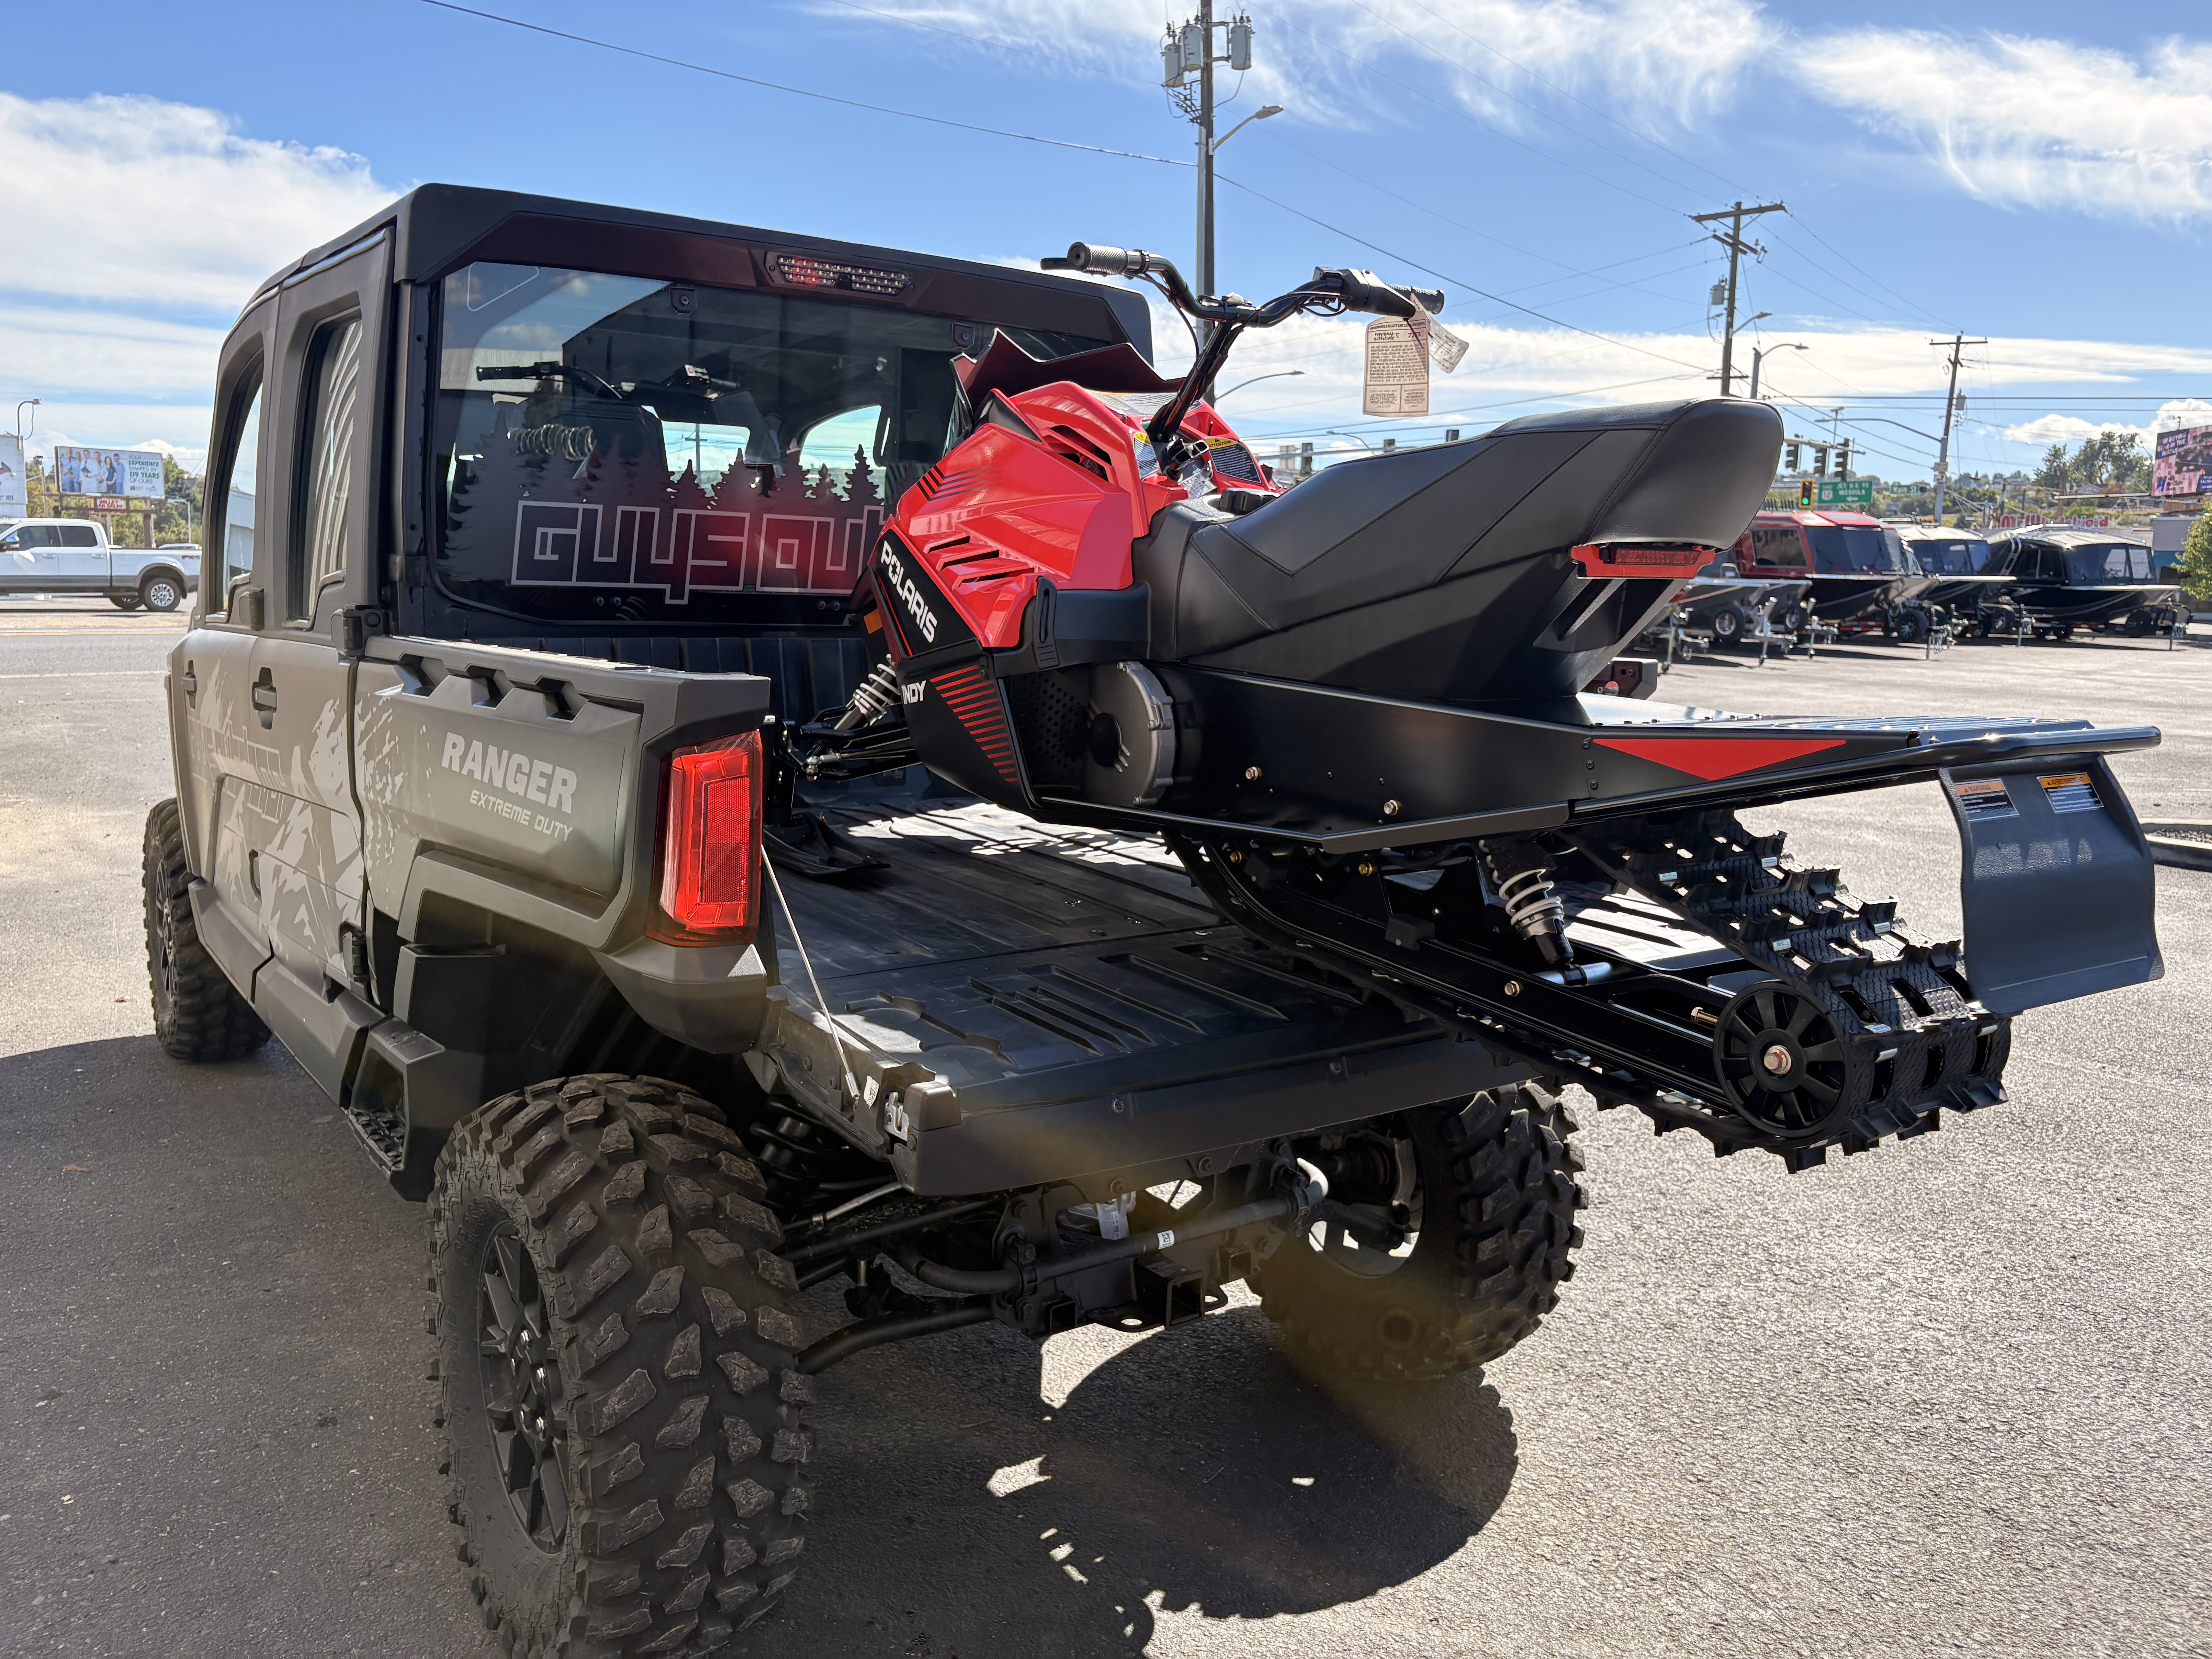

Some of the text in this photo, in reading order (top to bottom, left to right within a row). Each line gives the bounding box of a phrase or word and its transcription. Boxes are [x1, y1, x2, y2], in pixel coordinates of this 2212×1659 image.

[880, 540, 938, 643] POLARIS
[902, 680, 926, 704] INDY
[441, 732, 577, 814] RANGER
[469, 789, 574, 841] EXTREME DUTY
